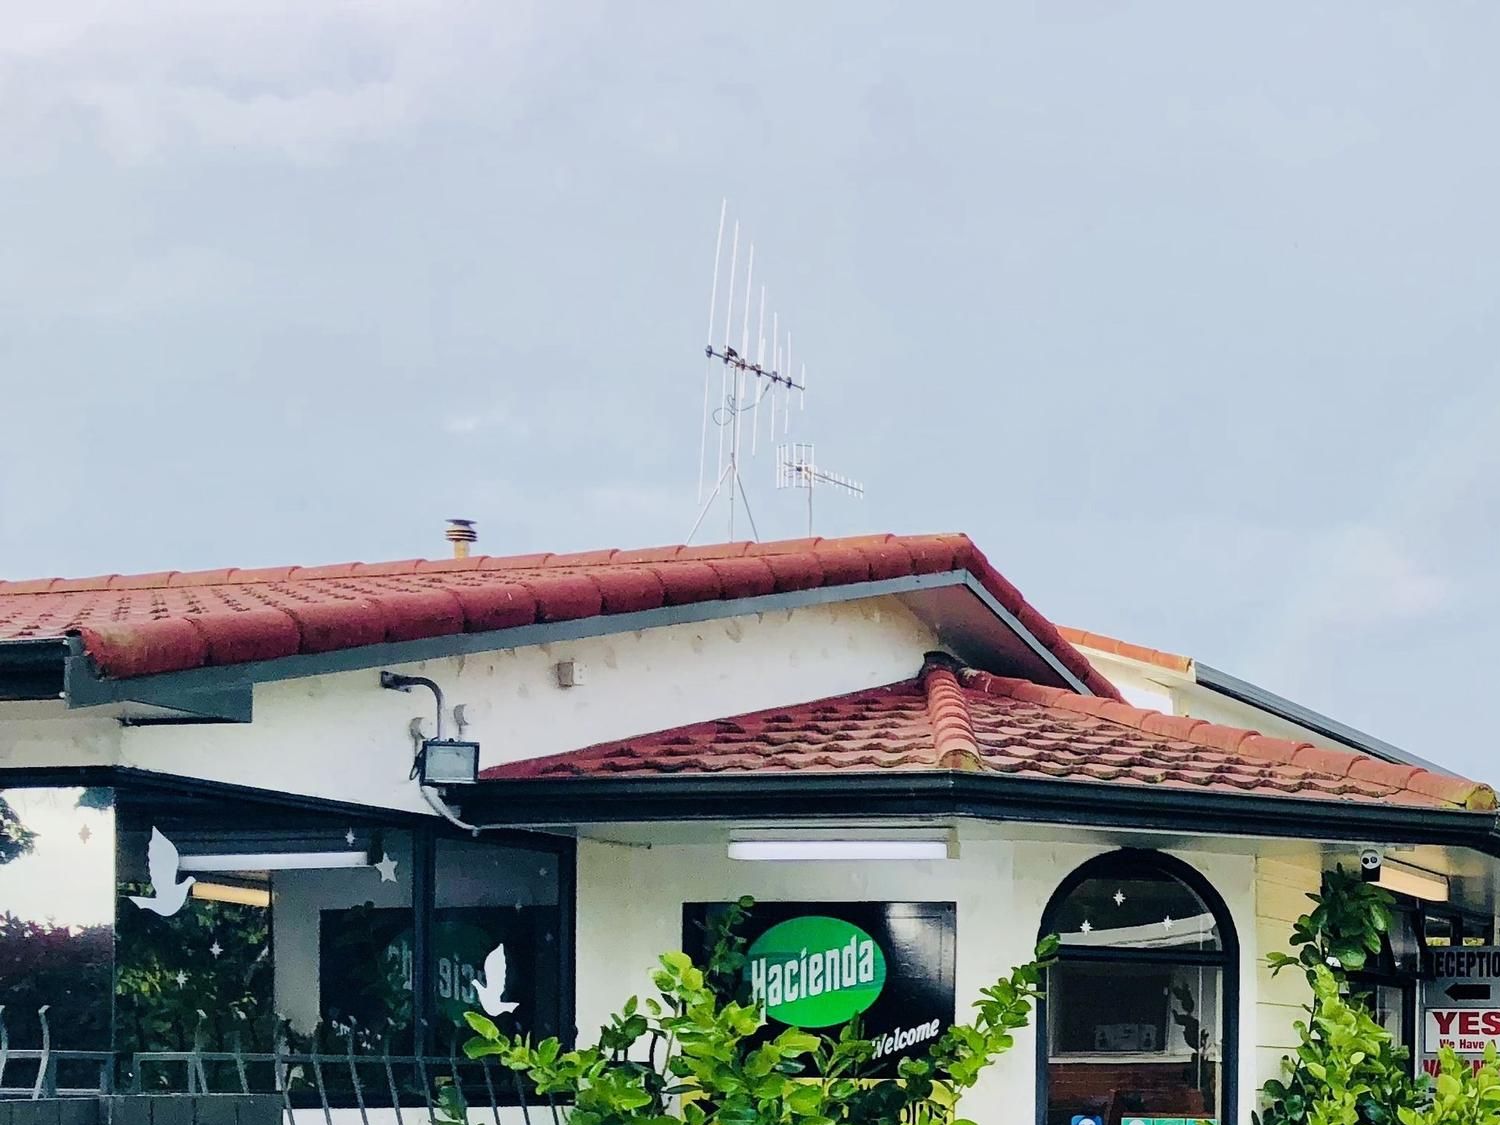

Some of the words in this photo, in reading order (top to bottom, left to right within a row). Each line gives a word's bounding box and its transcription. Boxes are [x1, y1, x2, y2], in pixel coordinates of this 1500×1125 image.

[752, 935, 874, 1025] Hacienda
[872, 1018, 940, 1060] Welcome
[1459, 1039, 1485, 1049] Have
